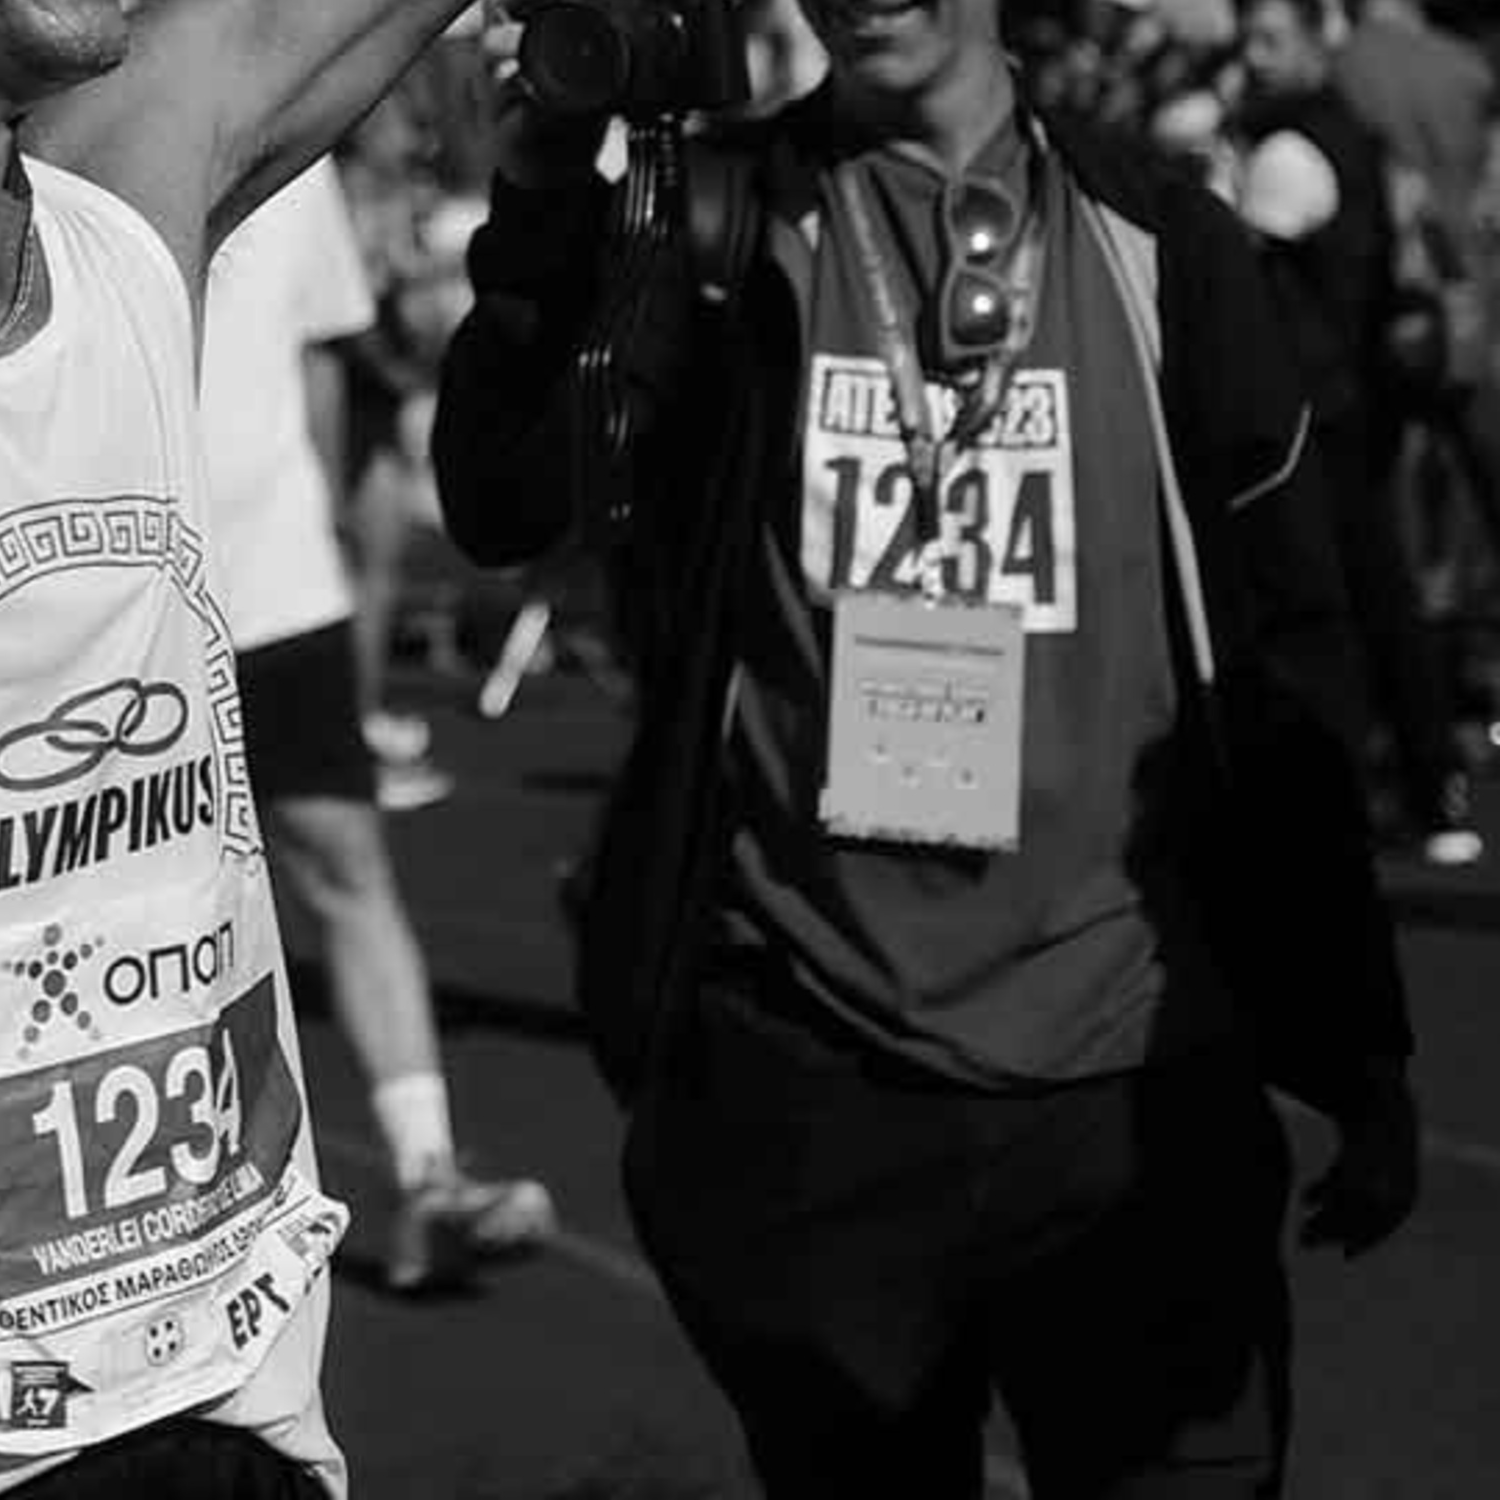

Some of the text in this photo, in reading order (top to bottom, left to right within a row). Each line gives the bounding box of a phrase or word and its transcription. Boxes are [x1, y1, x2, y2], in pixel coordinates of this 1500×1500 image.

[825, 456, 1056, 606] 1234
[32, 1027, 241, 1219] 1234
[32, 1216, 142, 1276] VANDERLEI
